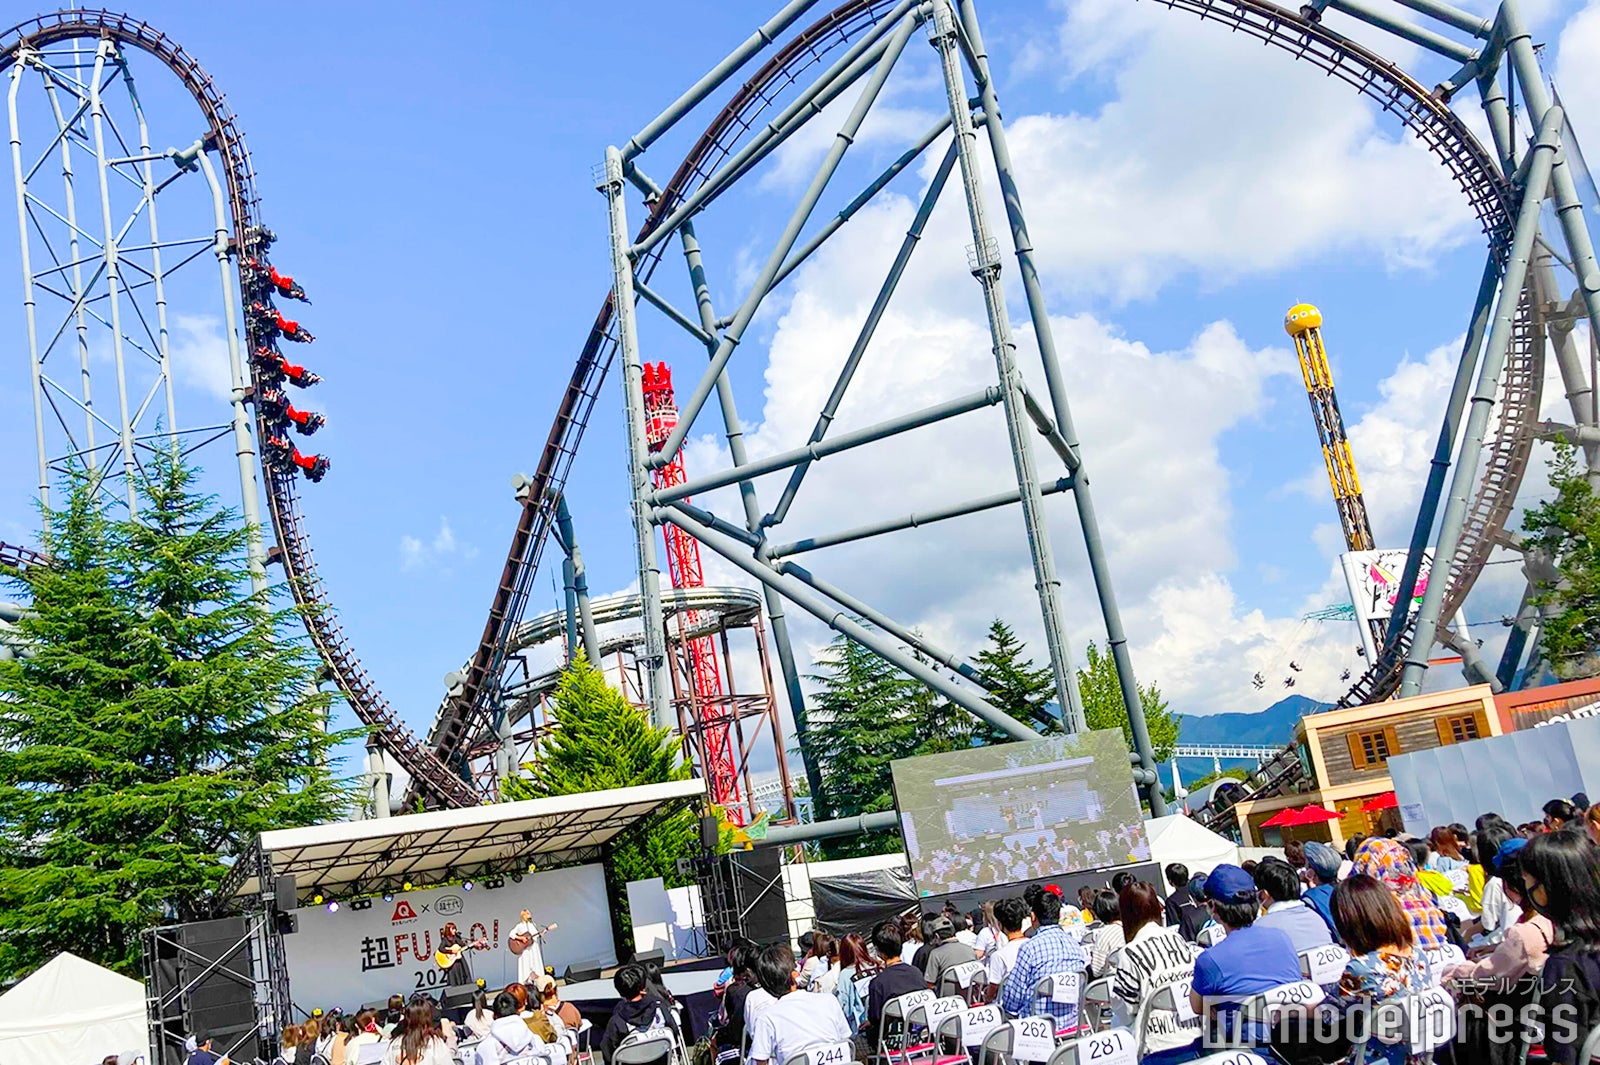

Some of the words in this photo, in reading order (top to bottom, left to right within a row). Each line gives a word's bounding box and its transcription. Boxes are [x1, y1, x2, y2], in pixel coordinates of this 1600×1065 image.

[1316, 947, 1343, 966] 260
[960, 961, 980, 975] 166
[414, 968, 450, 988] 202
[1058, 974, 1077, 987] 223
[905, 991, 929, 1007] 205
[1276, 983, 1313, 1006] 280
[932, 999, 960, 1015] 224
[967, 1008, 995, 1026] 243
[1020, 1021, 1048, 1039] 262
[1089, 1033, 1123, 1060] 281
[815, 1047, 844, 1065] 244
